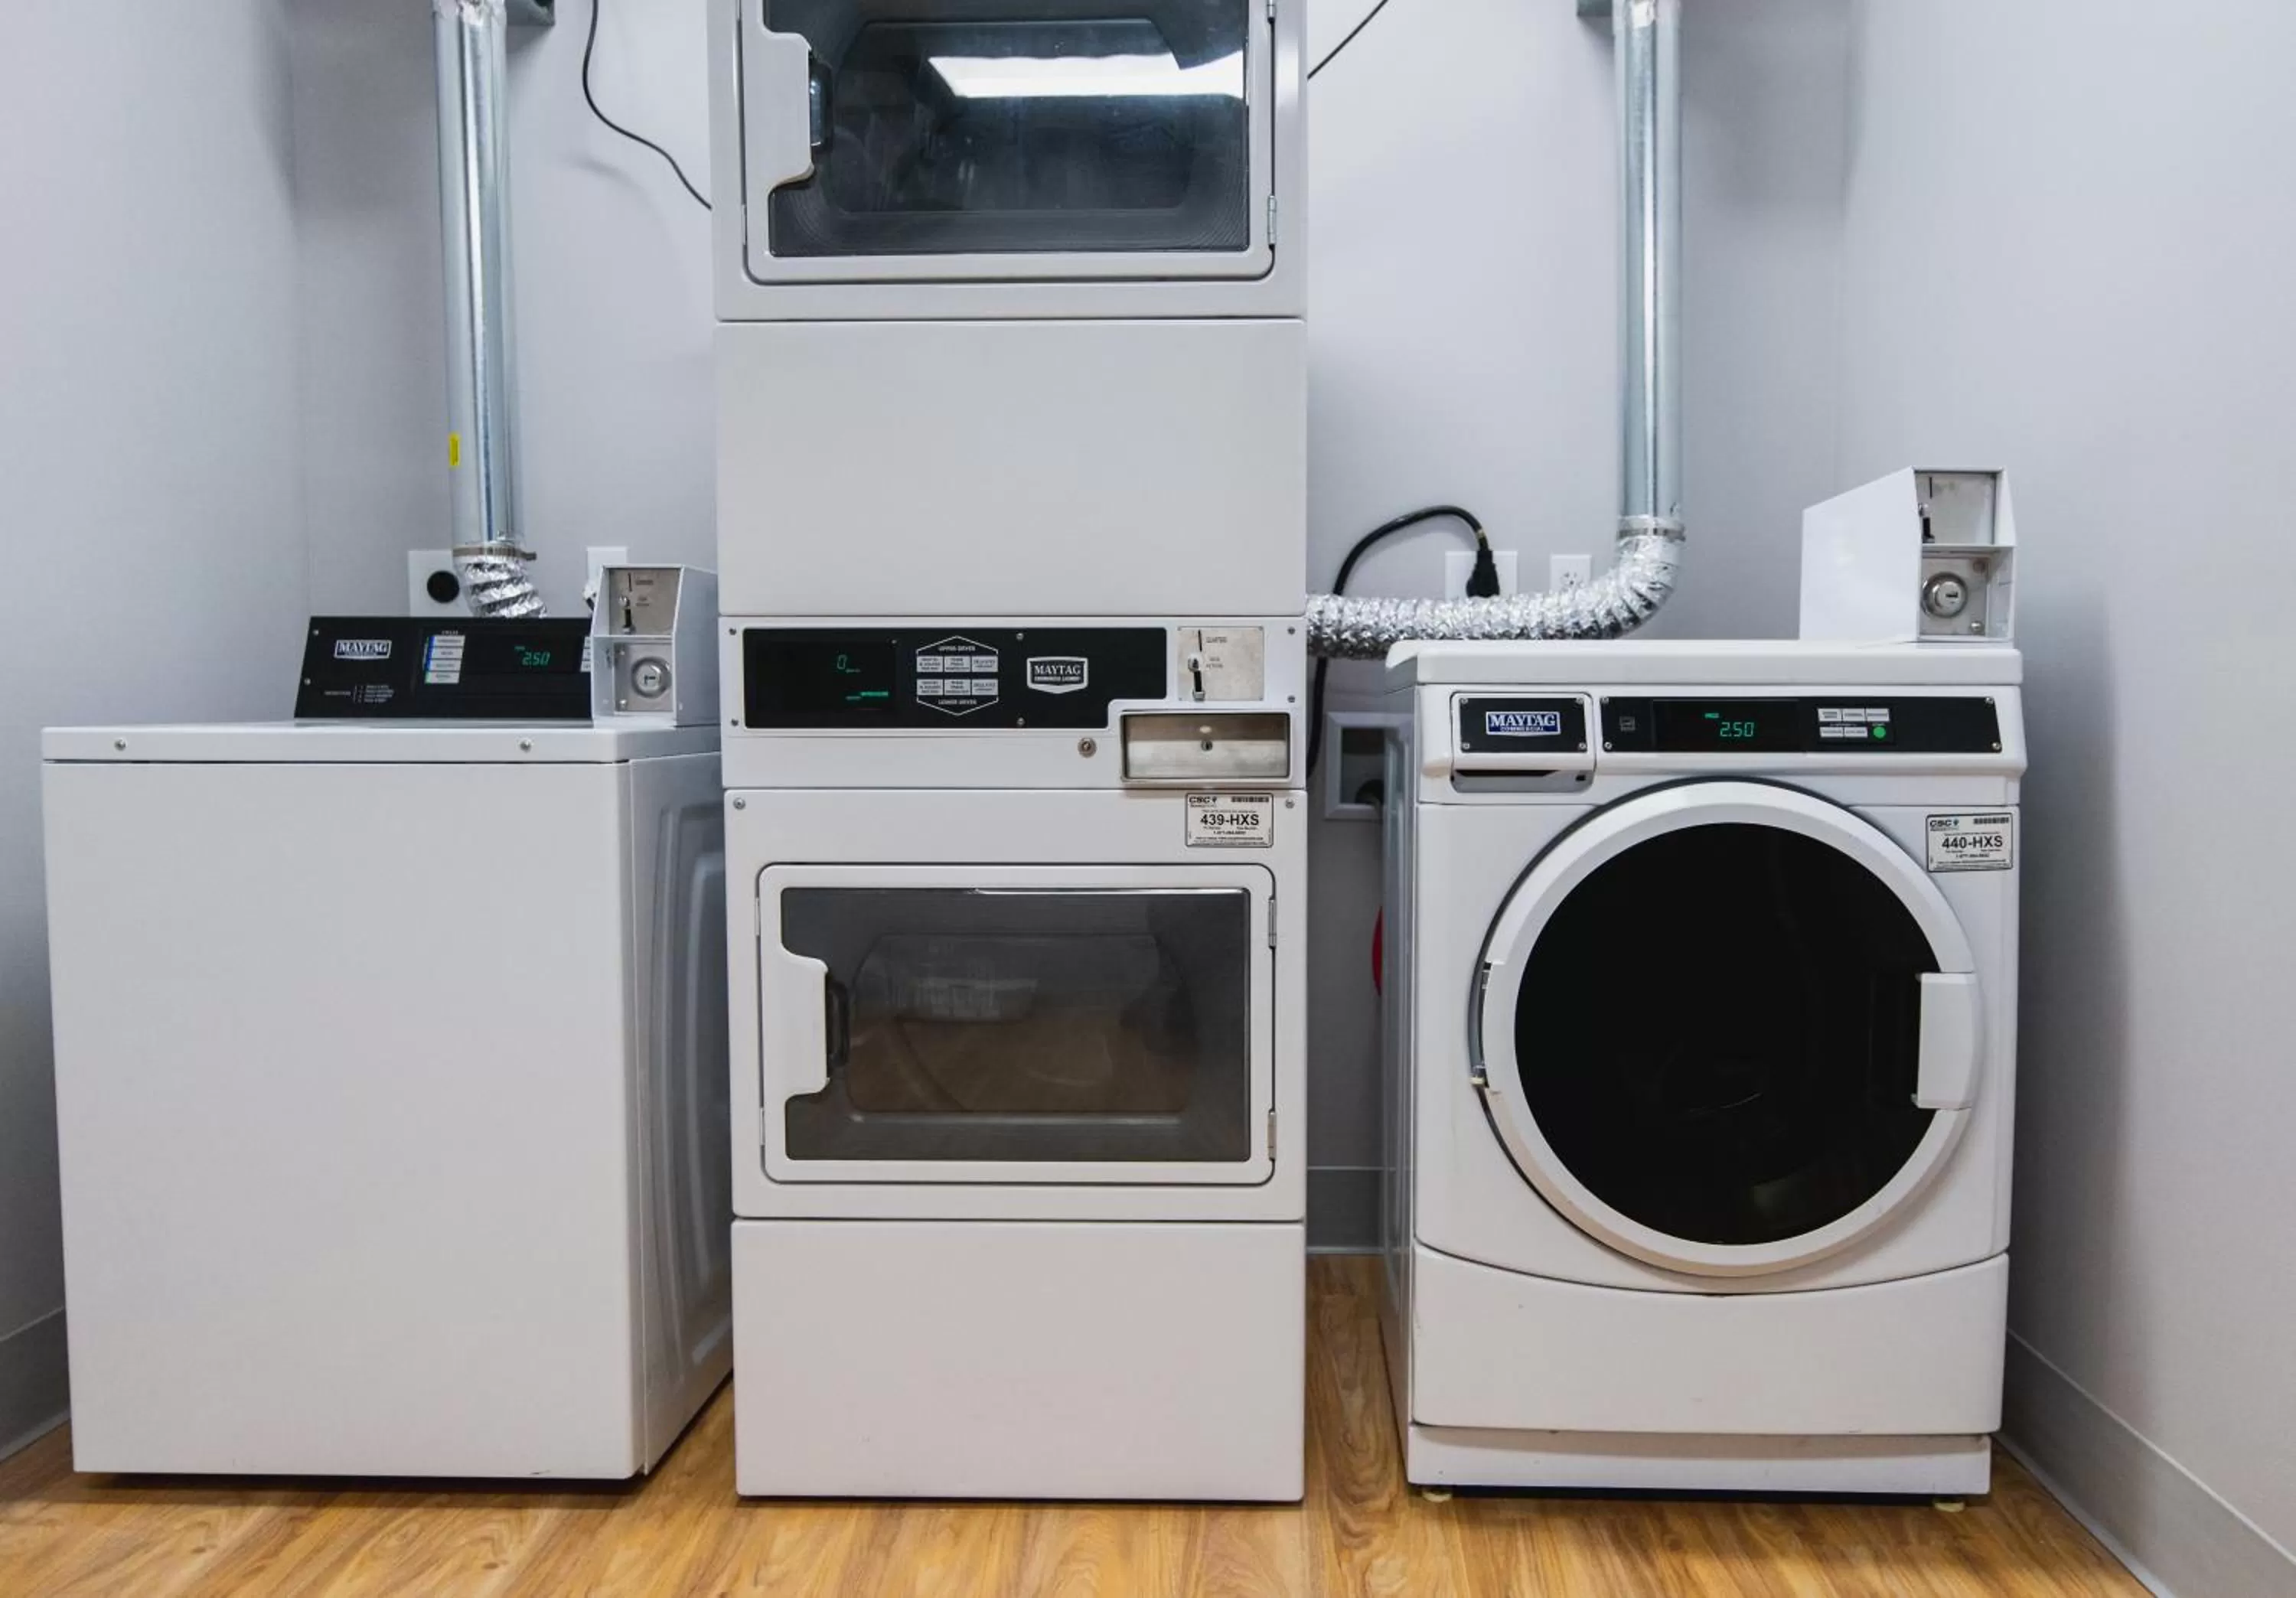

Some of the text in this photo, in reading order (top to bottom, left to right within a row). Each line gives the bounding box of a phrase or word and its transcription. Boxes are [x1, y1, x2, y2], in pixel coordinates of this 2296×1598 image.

[339, 641, 387, 652] MAYTAG
[1034, 665, 1081, 675] MAYTAG
[1489, 714, 1556, 727] MAYTAG
[1720, 722, 1754, 737] 2.50
[1200, 814, 1259, 826] 439-HXS
[1942, 835, 2003, 849] 440-HXS
